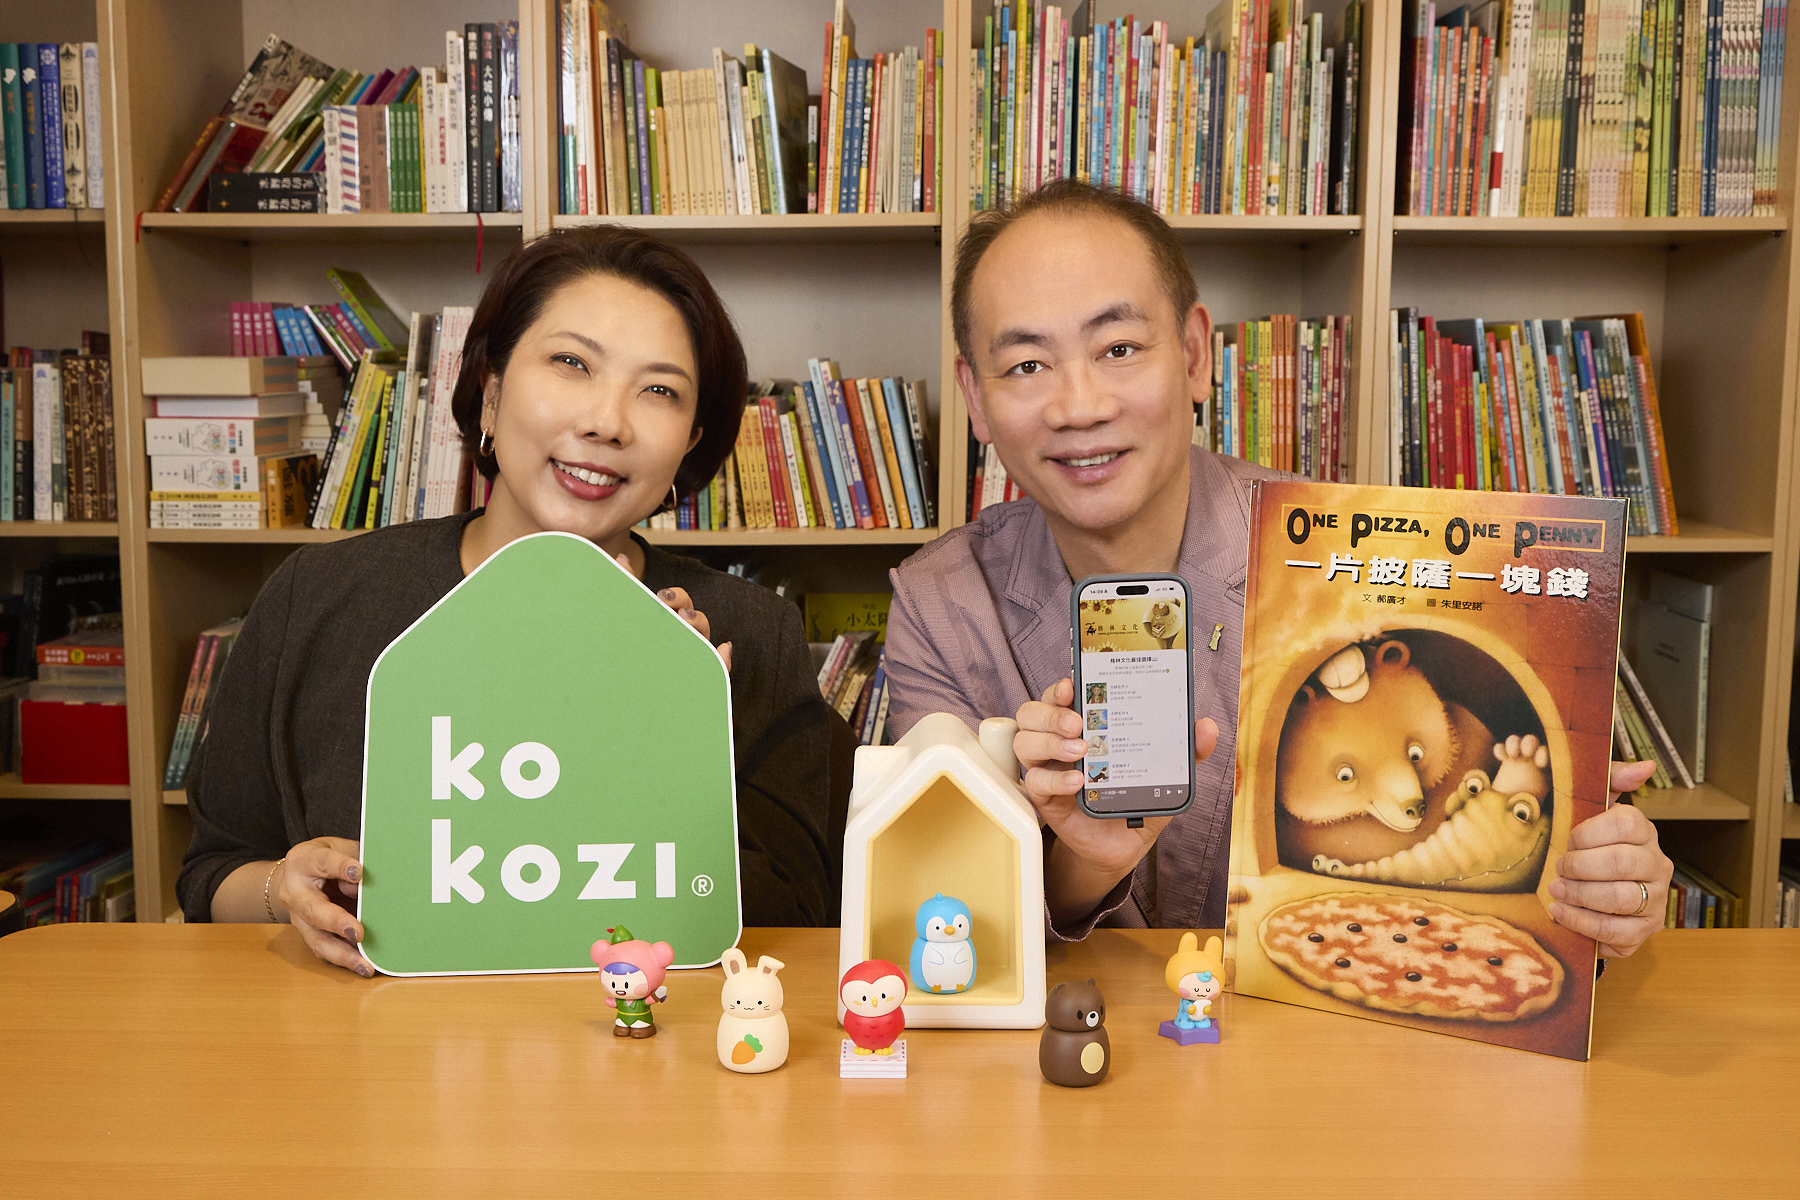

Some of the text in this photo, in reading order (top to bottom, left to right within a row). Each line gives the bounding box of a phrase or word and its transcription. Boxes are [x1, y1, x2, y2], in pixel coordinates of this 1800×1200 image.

[1513, 521, 1598, 558] PENNY
[1284, 553, 1590, 598] 一片披薩一塊錢
[1362, 593, 1372, 603] 文
[1376, 594, 1407, 605] 郝廣才
[1441, 599, 1484, 612] 朱里安諾
[431, 715, 560, 801] ko
